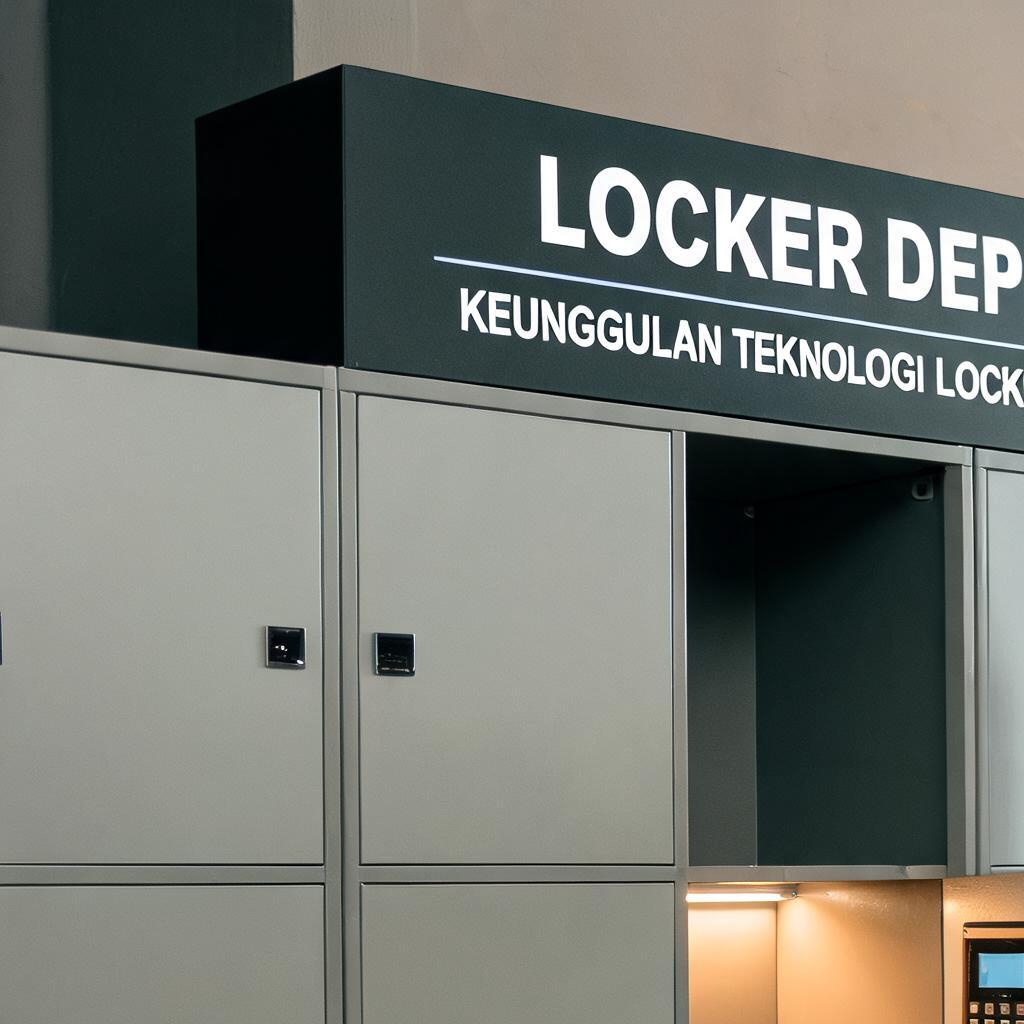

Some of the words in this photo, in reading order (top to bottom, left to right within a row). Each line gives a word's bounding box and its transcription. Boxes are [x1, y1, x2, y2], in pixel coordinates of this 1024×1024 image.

[539, 154, 868, 296] LOCKER
[460, 287, 722, 366] KEUNGGULAN
[732, 327, 925, 394] TEKNOLOGI
